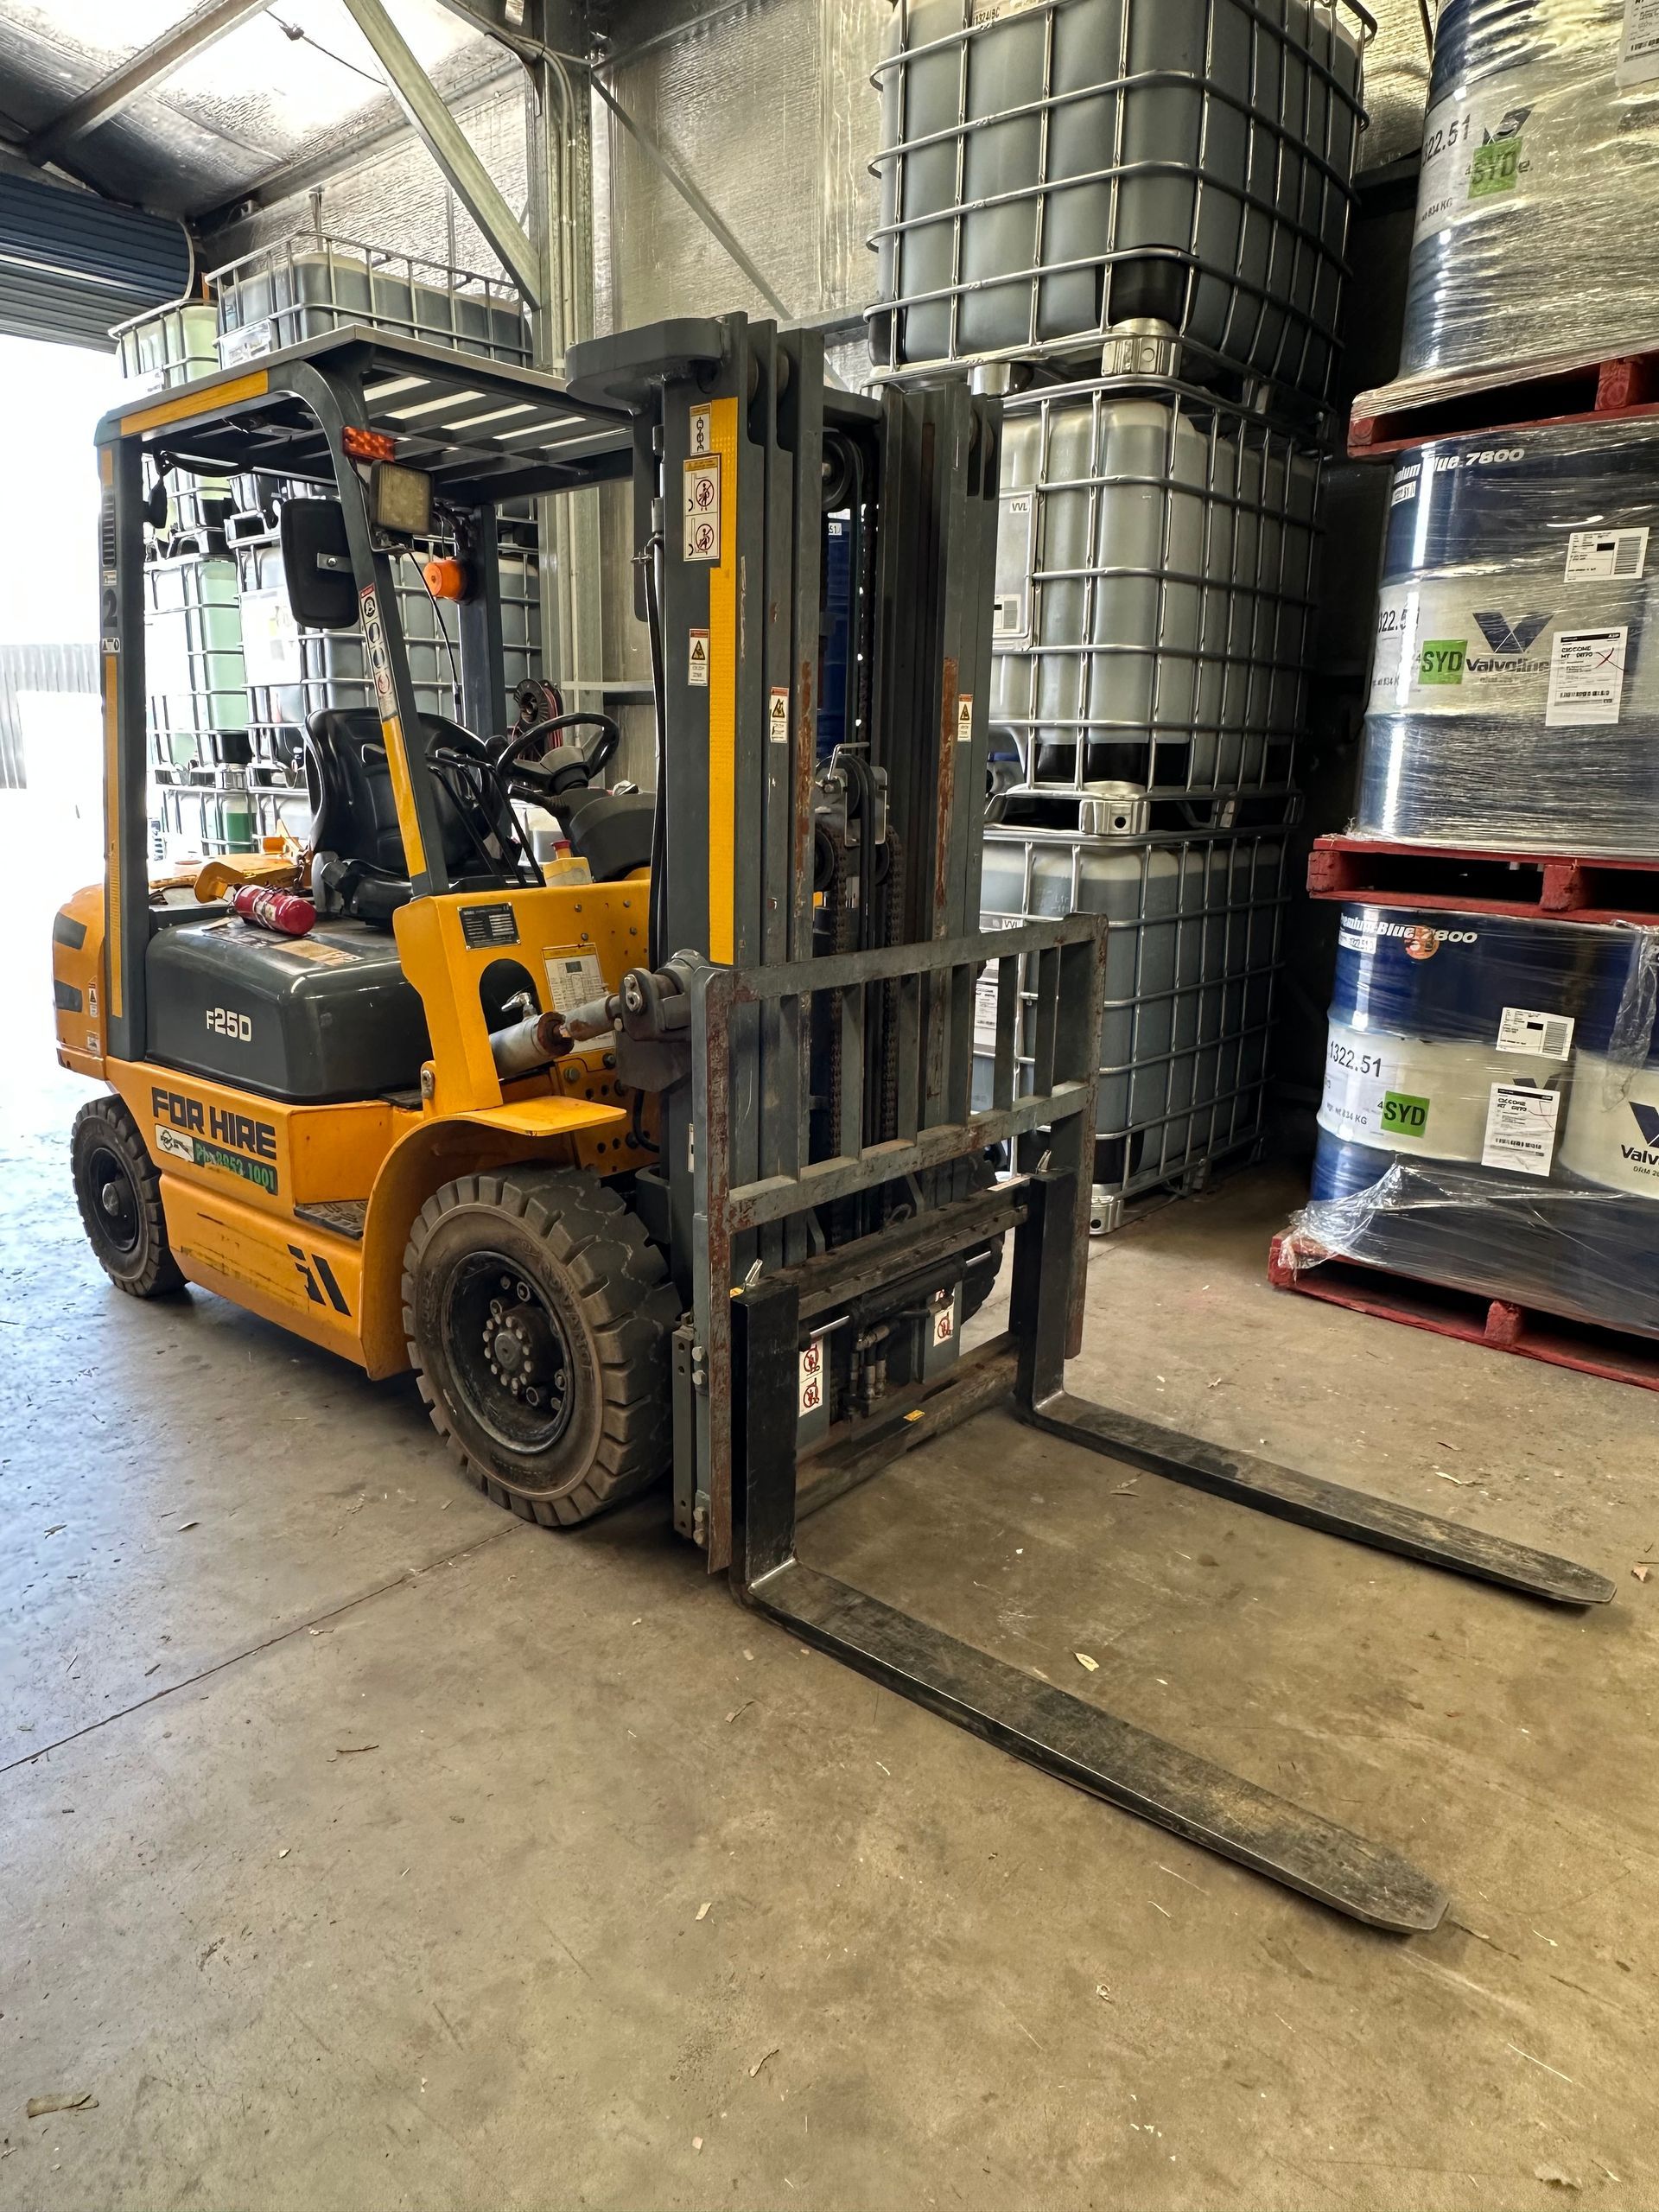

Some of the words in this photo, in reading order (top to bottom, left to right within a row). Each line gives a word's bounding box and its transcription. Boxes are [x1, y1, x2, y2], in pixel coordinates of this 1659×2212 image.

[1465, 448, 1525, 466] 7800
[1011, 502, 1028, 512] VVL
[1421, 651, 1464, 673] SYD
[1376, 922, 1415, 938] Blue
[206, 1007, 252, 1042] F25D
[1330, 1040, 1382, 1077] 1322.51
[151, 1086, 206, 1135] FOR
[209, 1105, 277, 1161] HIRE
[1354, 1114, 1368, 1125] KG
[1383, 1101, 1427, 1127] SYD
